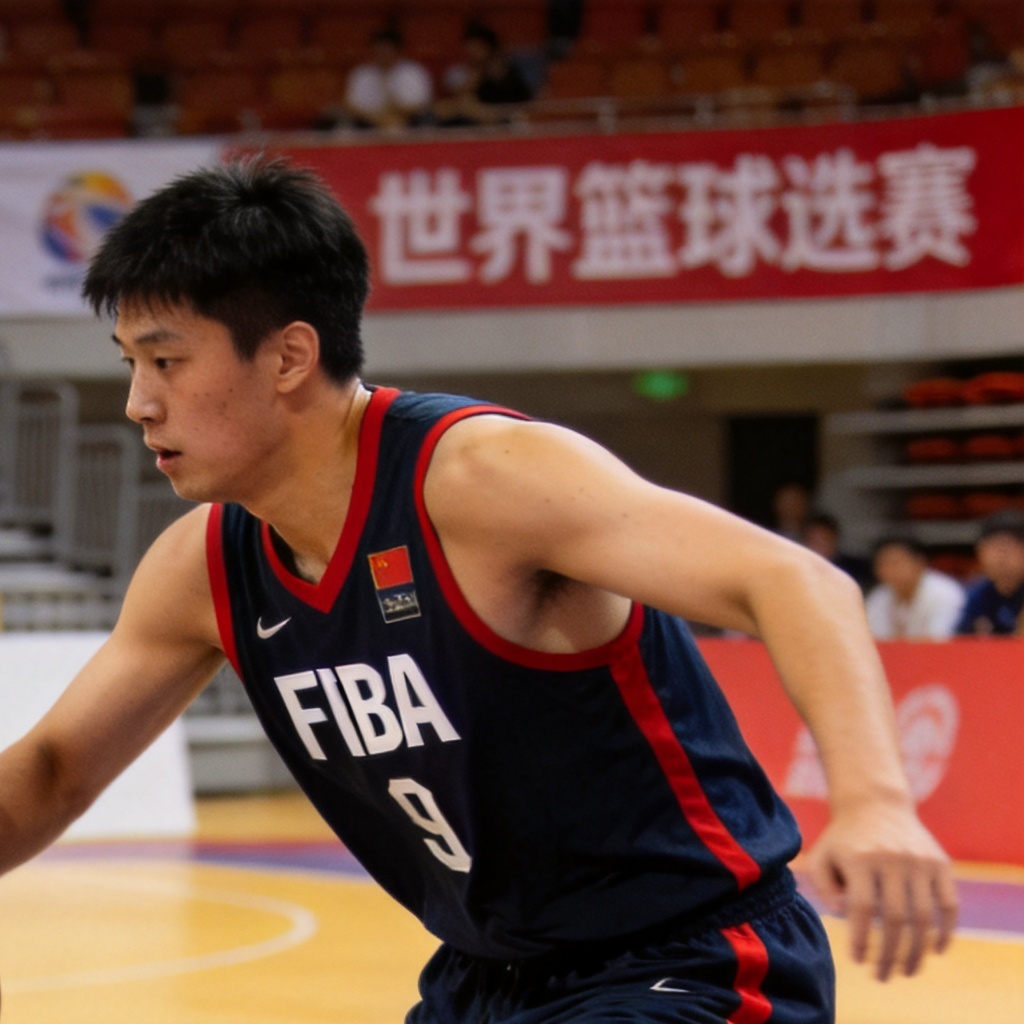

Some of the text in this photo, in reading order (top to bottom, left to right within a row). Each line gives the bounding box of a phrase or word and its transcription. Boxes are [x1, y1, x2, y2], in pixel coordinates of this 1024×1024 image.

[372, 144, 976, 285] 世界篮球选赛
[274, 653, 461, 761] FIBA
[388, 778, 472, 874] 9
